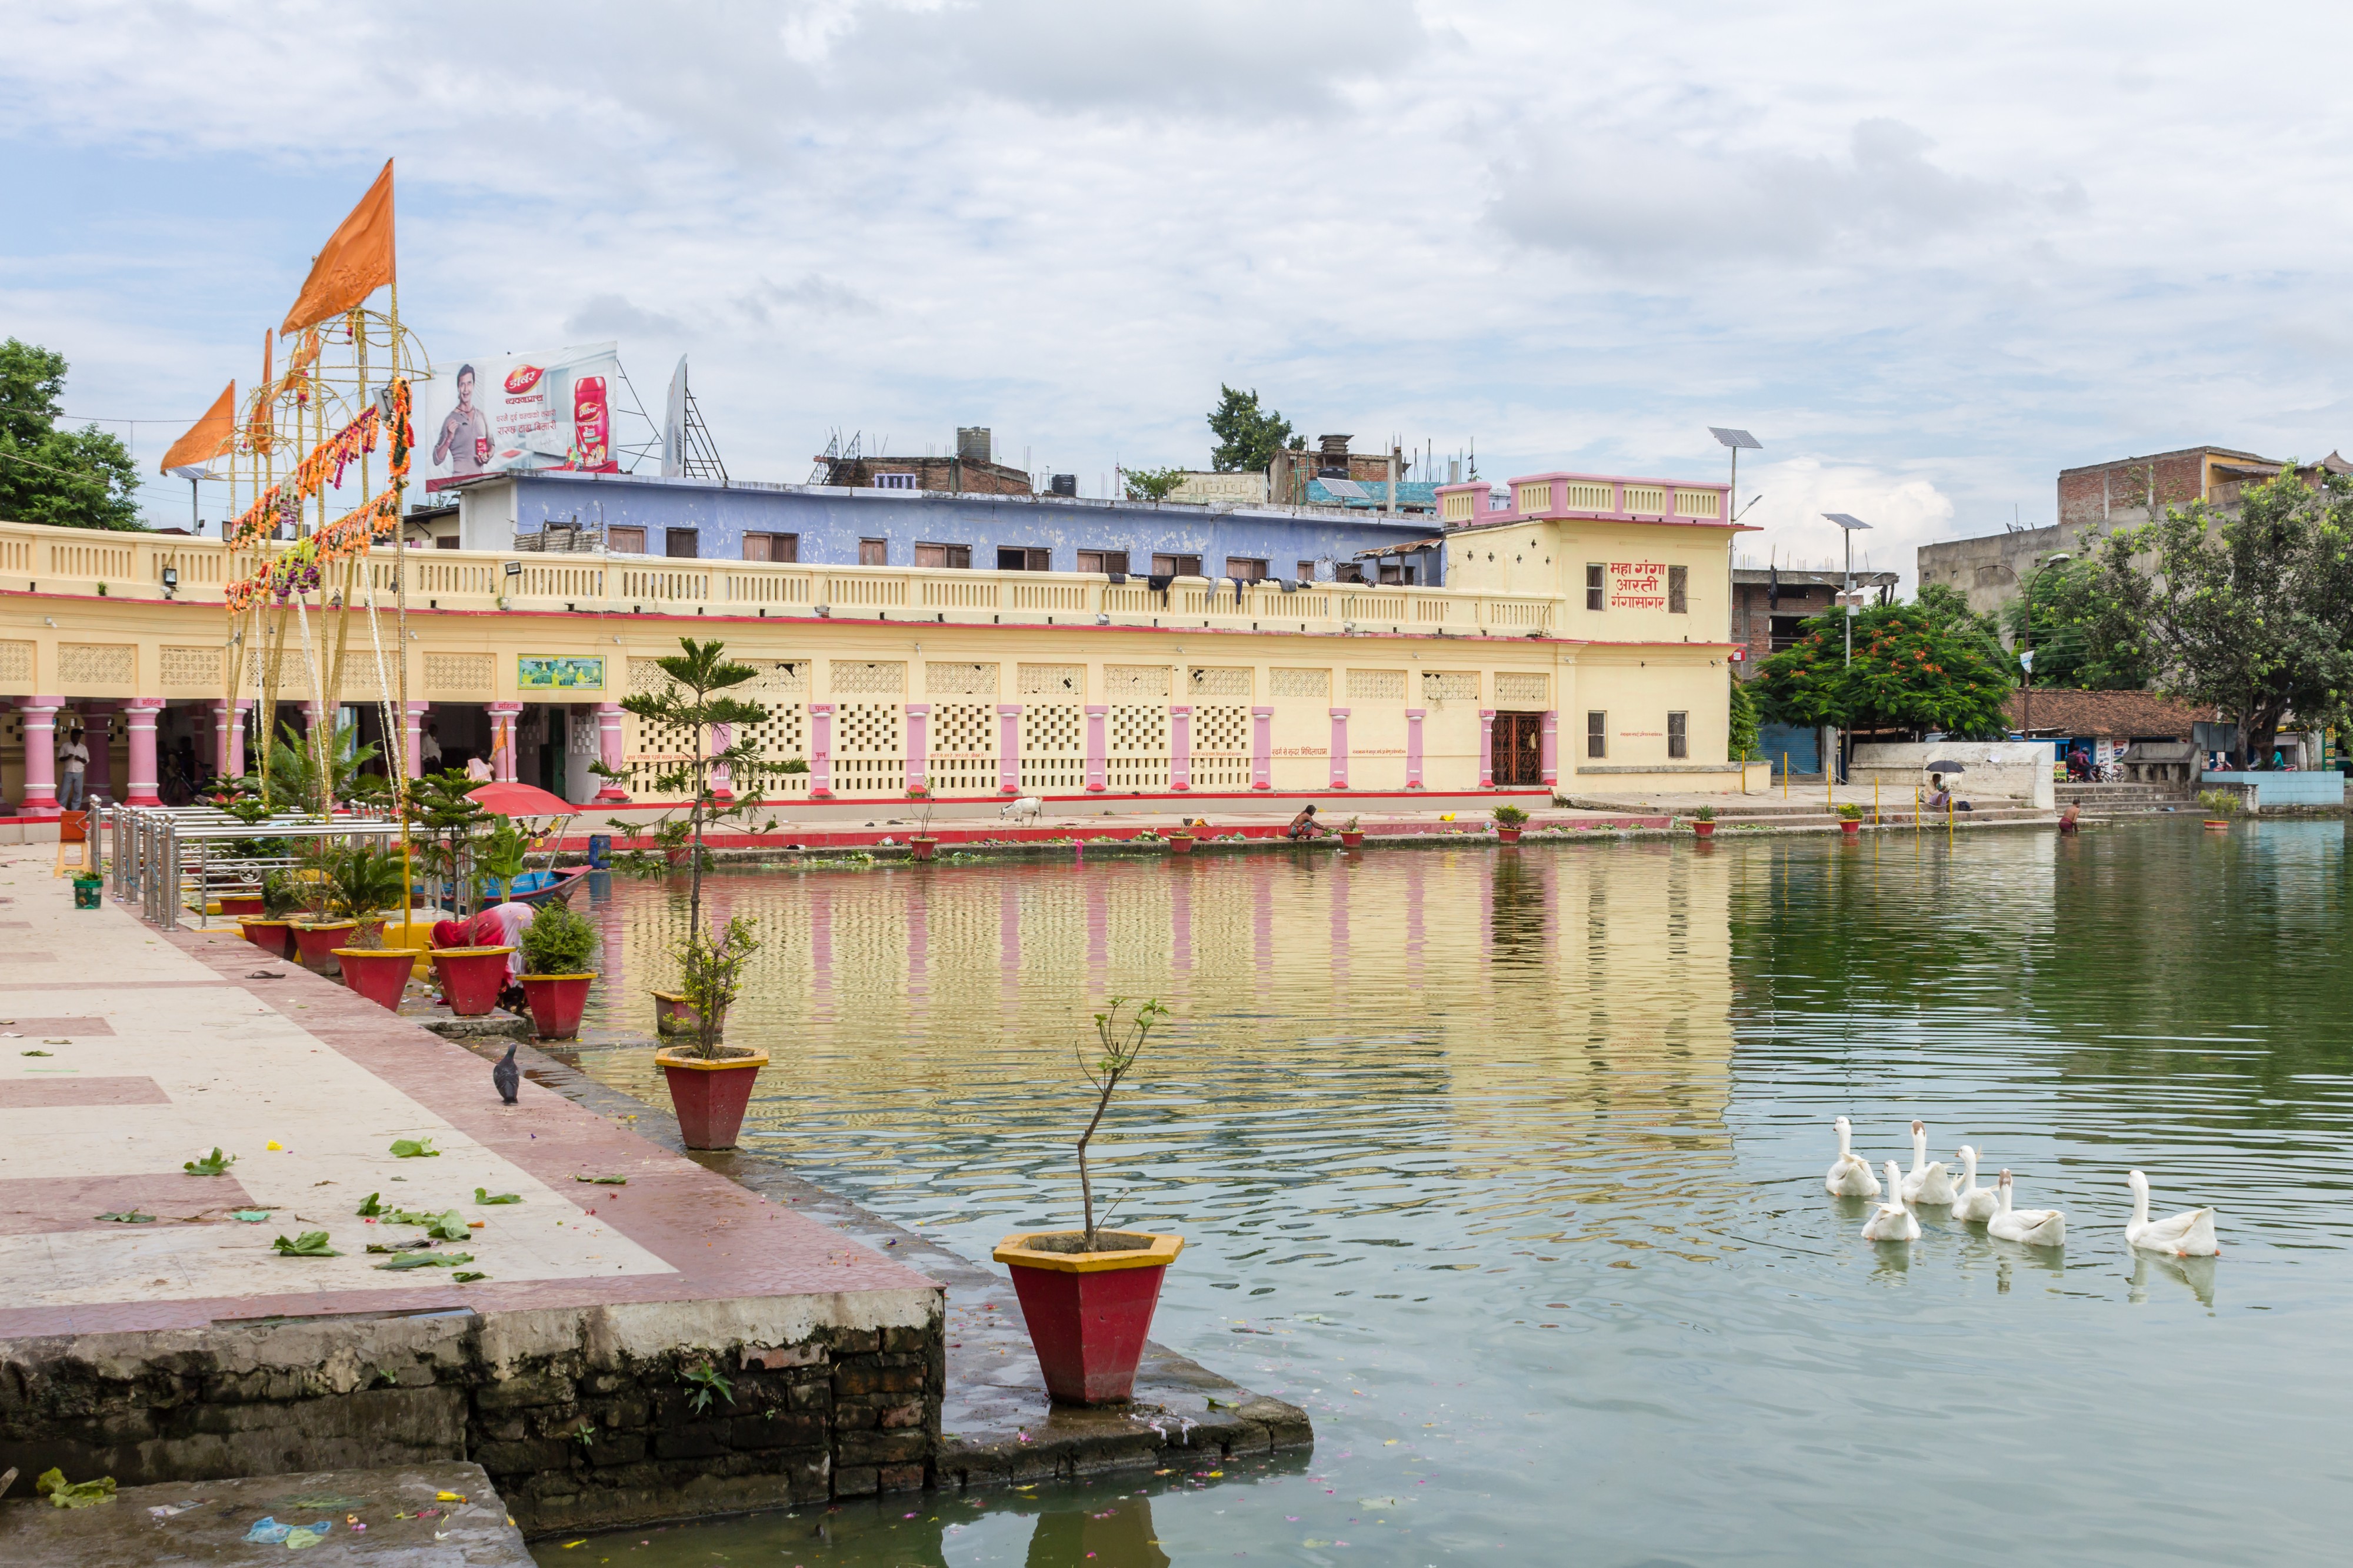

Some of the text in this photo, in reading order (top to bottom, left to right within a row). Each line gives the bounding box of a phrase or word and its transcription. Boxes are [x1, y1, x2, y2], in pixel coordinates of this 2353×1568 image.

[509, 371, 536, 389] डाबर
[579, 406, 598, 417] Dabur
[534, 420, 556, 431] बिमारी
[1610, 559, 1666, 577] महा गंगा
[1616, 576, 1658, 592] आरती
[1611, 593, 1665, 612] गंगासागर
[1272, 746, 1327, 756] स्वर्ग से सुन्दर मिथिलाधाम
